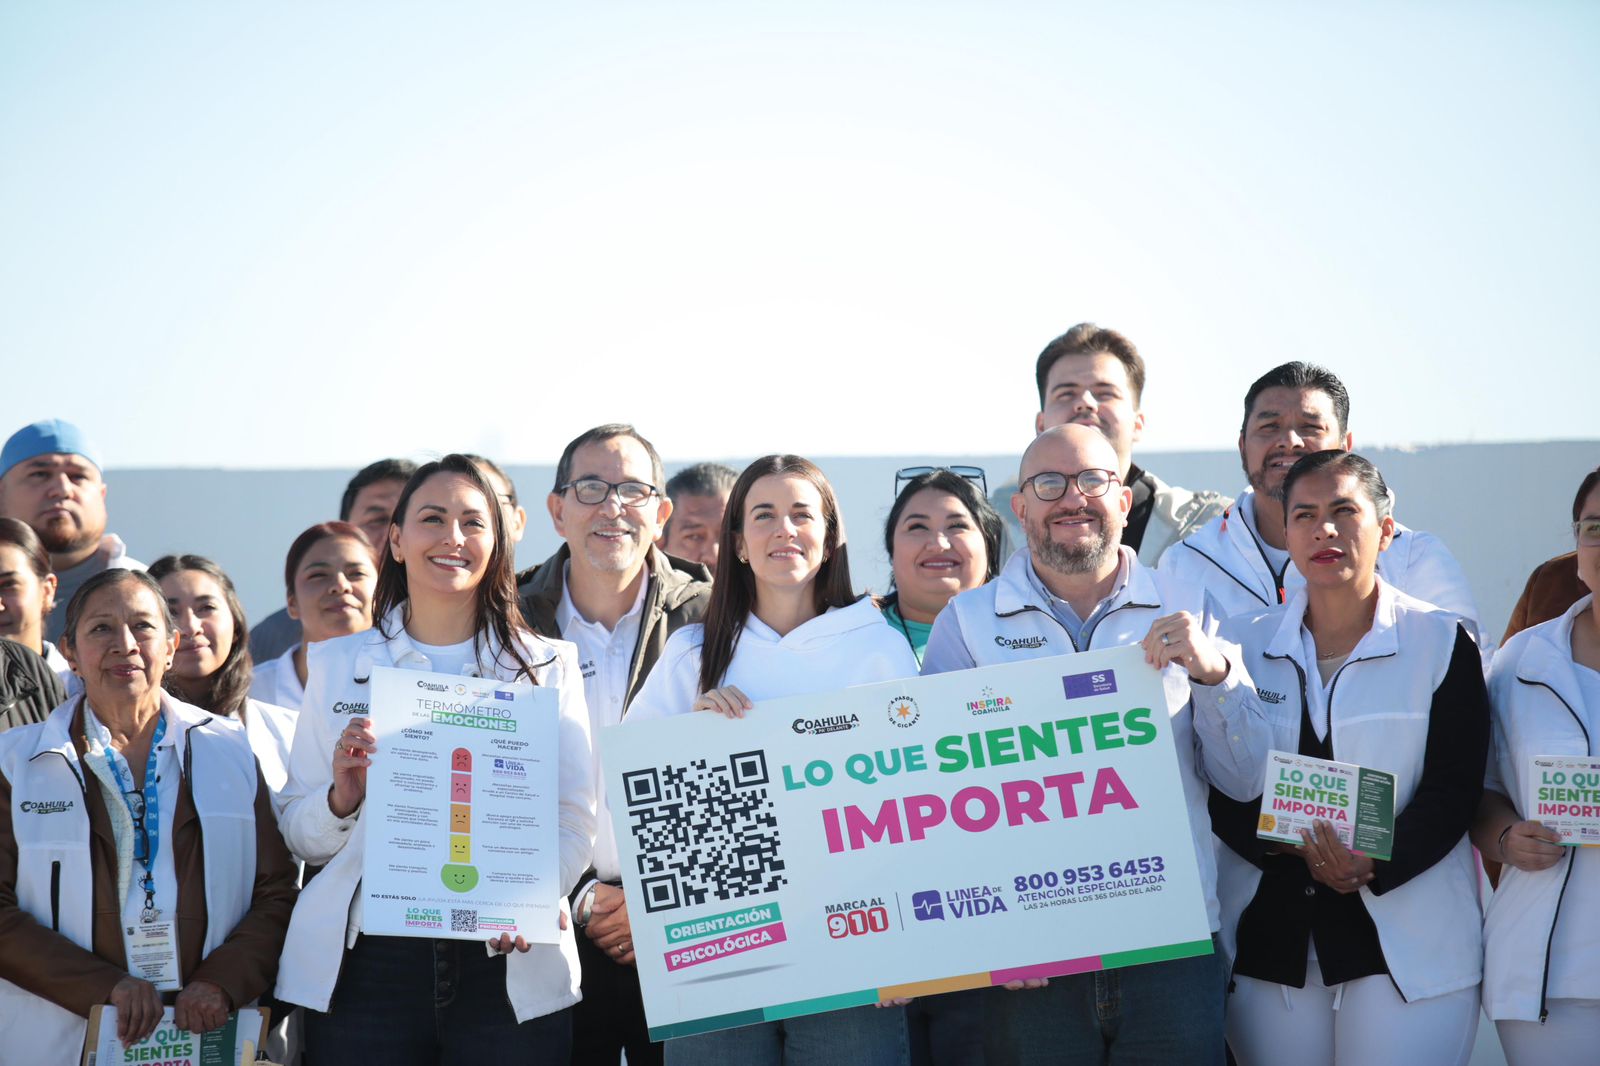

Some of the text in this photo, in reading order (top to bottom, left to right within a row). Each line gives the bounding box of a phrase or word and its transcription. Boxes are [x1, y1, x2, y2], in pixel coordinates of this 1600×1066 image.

[995, 636, 1048, 647] COAHUILA
[417, 680, 449, 690] COAHUILA
[1091, 674, 1105, 683] SS
[967, 696, 1012, 711] INSPIRA
[1256, 688, 1286, 701] AHUILA
[333, 702, 368, 713] COAHU
[416, 698, 511, 719] TERMÓMETRO
[972, 706, 1010, 715] COAHUILA
[433, 712, 515, 731] EMOCIONES
[792, 714, 859, 734] COAHUILA
[782, 707, 1157, 791] LO QUE SIENTES
[1280, 768, 1303, 783] LO
[1309, 773, 1347, 792] QUE
[1542, 772, 1600, 789] LO QU
[1274, 783, 1349, 807] SIENTES
[1538, 787, 1600, 802] SIENTE
[20, 801, 74, 813] COAHUILA
[822, 767, 1139, 854] IMPORTA
[1272, 798, 1347, 822] IMPORTA
[1538, 803, 1600, 817] IMPORT
[1014, 856, 1165, 892] 800 953 6453
[946, 886, 992, 902] LINEA
[1017, 874, 1166, 903] ATENCIÓN ESPECIALIZADA
[1050, 897, 1077, 907] HORAS
[1094, 893, 1108, 901] 365
[1109, 890, 1127, 900] DÍAS
[1128, 888, 1144, 896] DEL
[1145, 884, 1162, 894] AÑO
[825, 898, 885, 914] MARCA AL
[948, 896, 1008, 919] VIDA
[670, 908, 771, 939] ORIENTACIÓN
[827, 906, 889, 939] 911
[670, 931, 772, 966] PSICOLÓGICA
[155, 1029, 190, 1045] QUE
[124, 1043, 193, 1062] SIENTES
